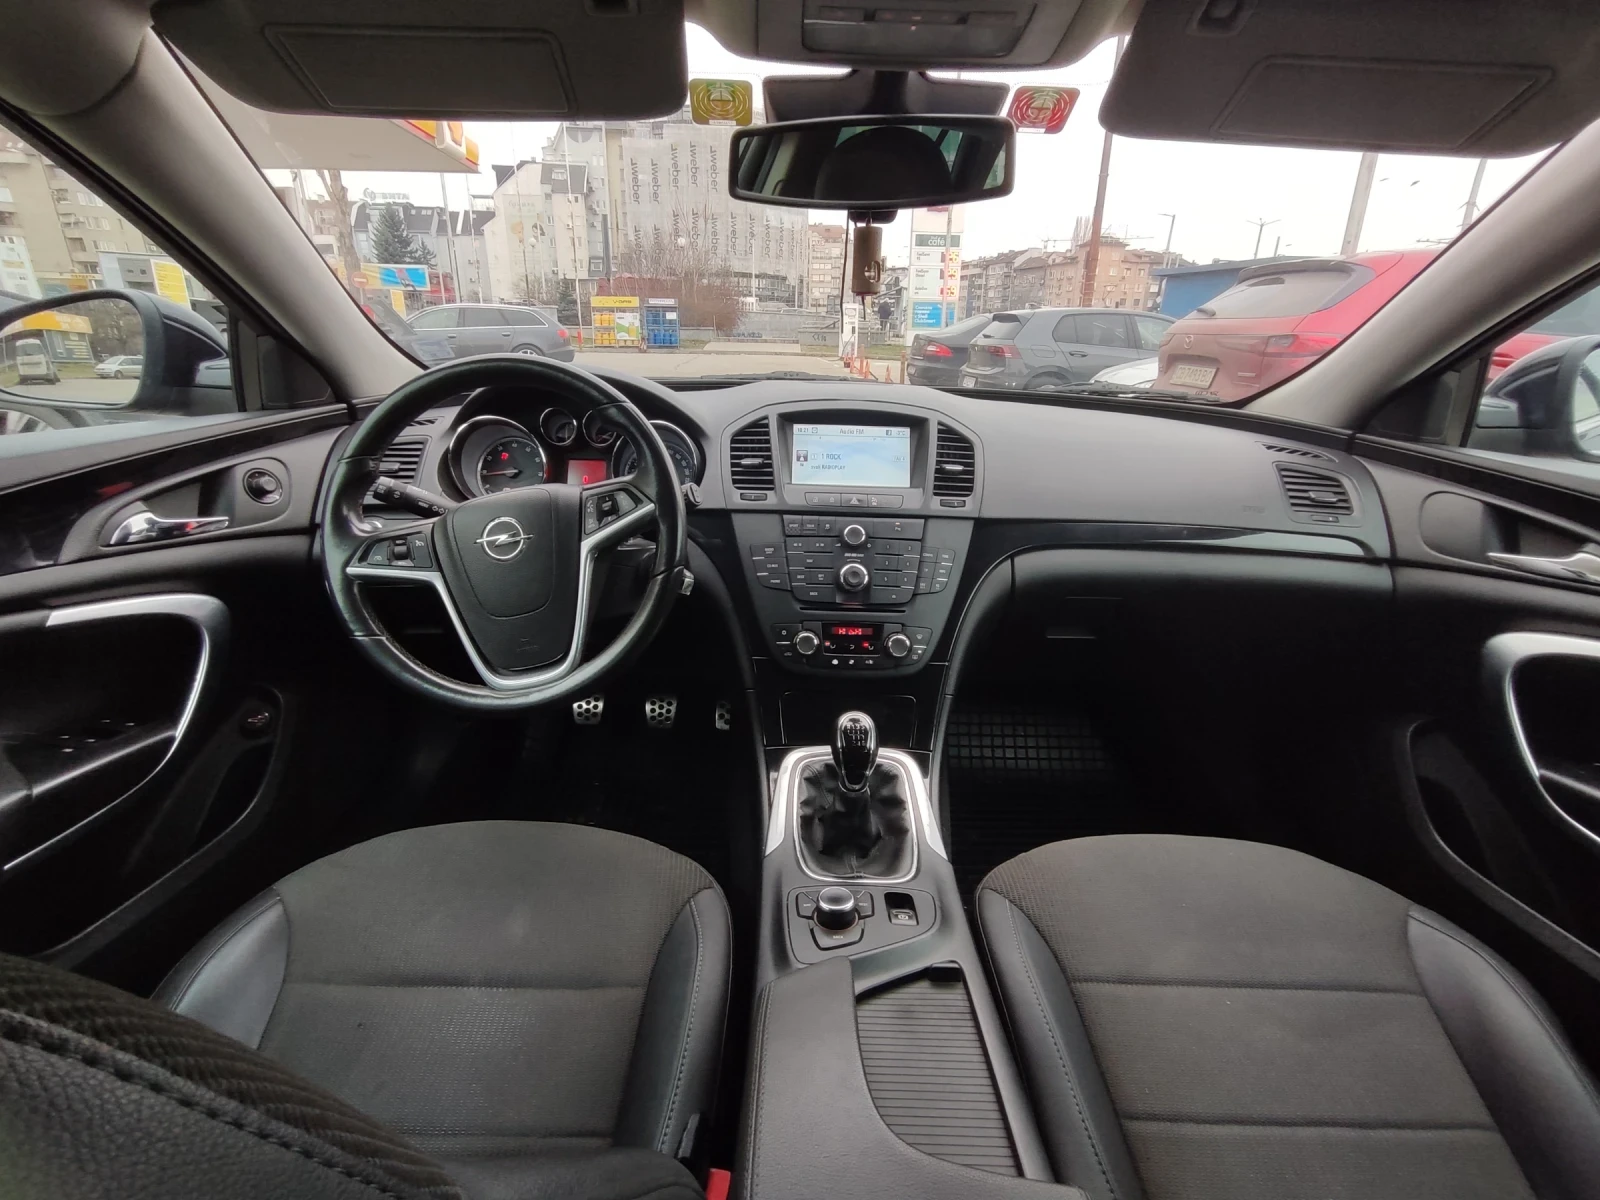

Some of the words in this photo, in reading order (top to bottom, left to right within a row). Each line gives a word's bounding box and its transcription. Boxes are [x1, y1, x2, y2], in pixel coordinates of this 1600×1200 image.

[631, 166, 641, 205] weber
[651, 166, 661, 205] weber
[670, 151, 681, 190] weber
[690, 148, 700, 188] weber
[710, 153, 720, 193] weber
[691, 215, 701, 252] weber
[711, 220, 720, 257] weber
[730, 220, 739, 256] weber
[764, 224, 772, 259] weber
[928, 237, 945, 246] café
